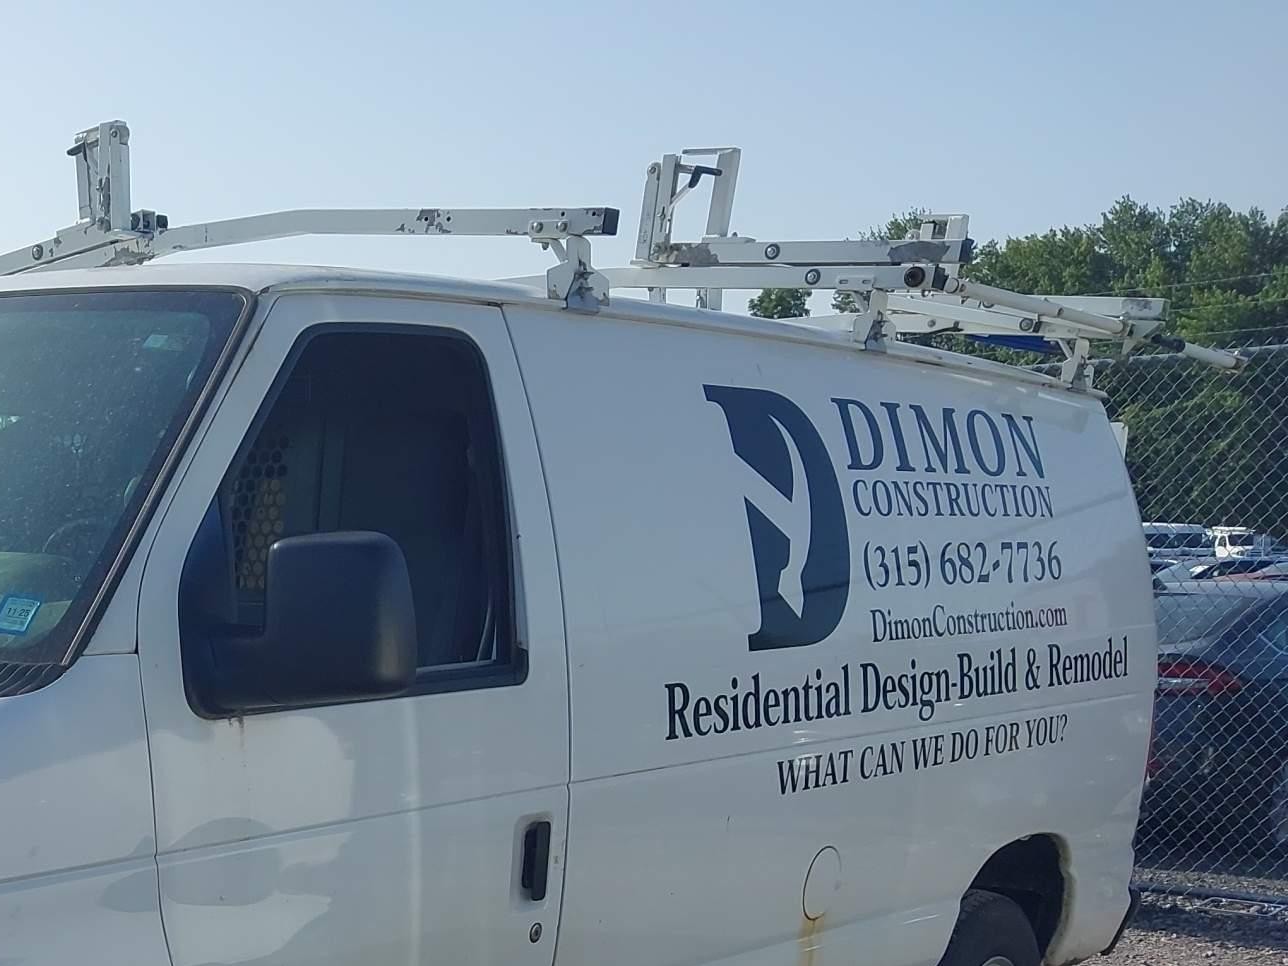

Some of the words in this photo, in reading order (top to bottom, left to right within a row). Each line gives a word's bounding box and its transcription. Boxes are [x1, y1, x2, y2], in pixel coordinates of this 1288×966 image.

[831, 397, 1046, 480] DIMON
[852, 479, 1055, 519] CONSTRUCTION
[863, 540, 931, 590] (315)
[940, 541, 1062, 584] 682-7736
[870, 602, 1068, 643] DimonConstruction.com
[664, 664, 851, 740] Residential
[860, 647, 1018, 721] Design-Build
[1025, 647, 1041, 691] &
[1048, 636, 1129, 687] Remodel
[776, 749, 854, 795] WHAT
[860, 741, 906, 779] CAN
[912, 734, 945, 770] WE
[950, 729, 979, 763] DO
[984, 722, 1019, 756] FOR
[1025, 713, 1069, 748] YOU?
